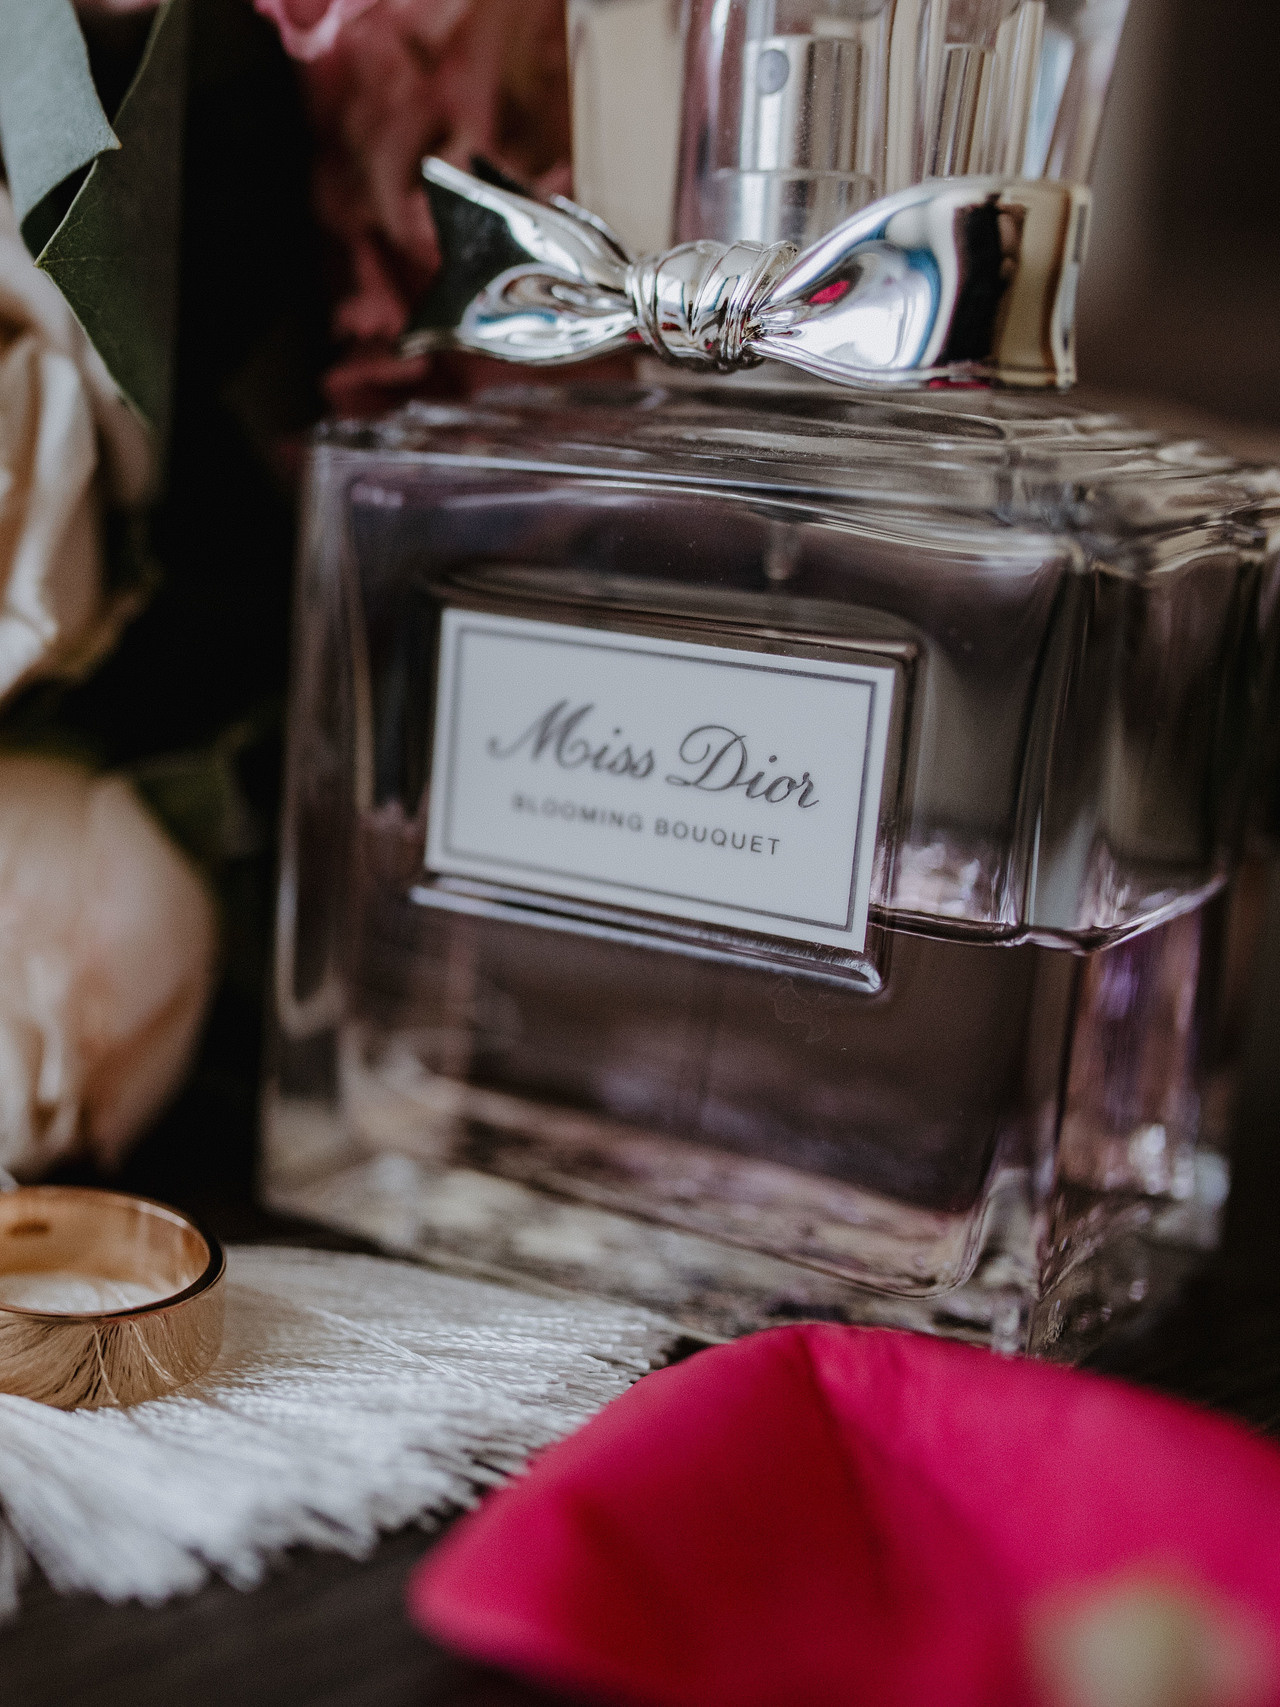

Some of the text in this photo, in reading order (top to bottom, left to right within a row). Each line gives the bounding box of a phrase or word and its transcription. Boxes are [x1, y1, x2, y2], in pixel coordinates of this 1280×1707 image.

[487, 699, 820, 808] Miss Dior
[512, 793, 781, 855] BLOOMING BOUQUET
